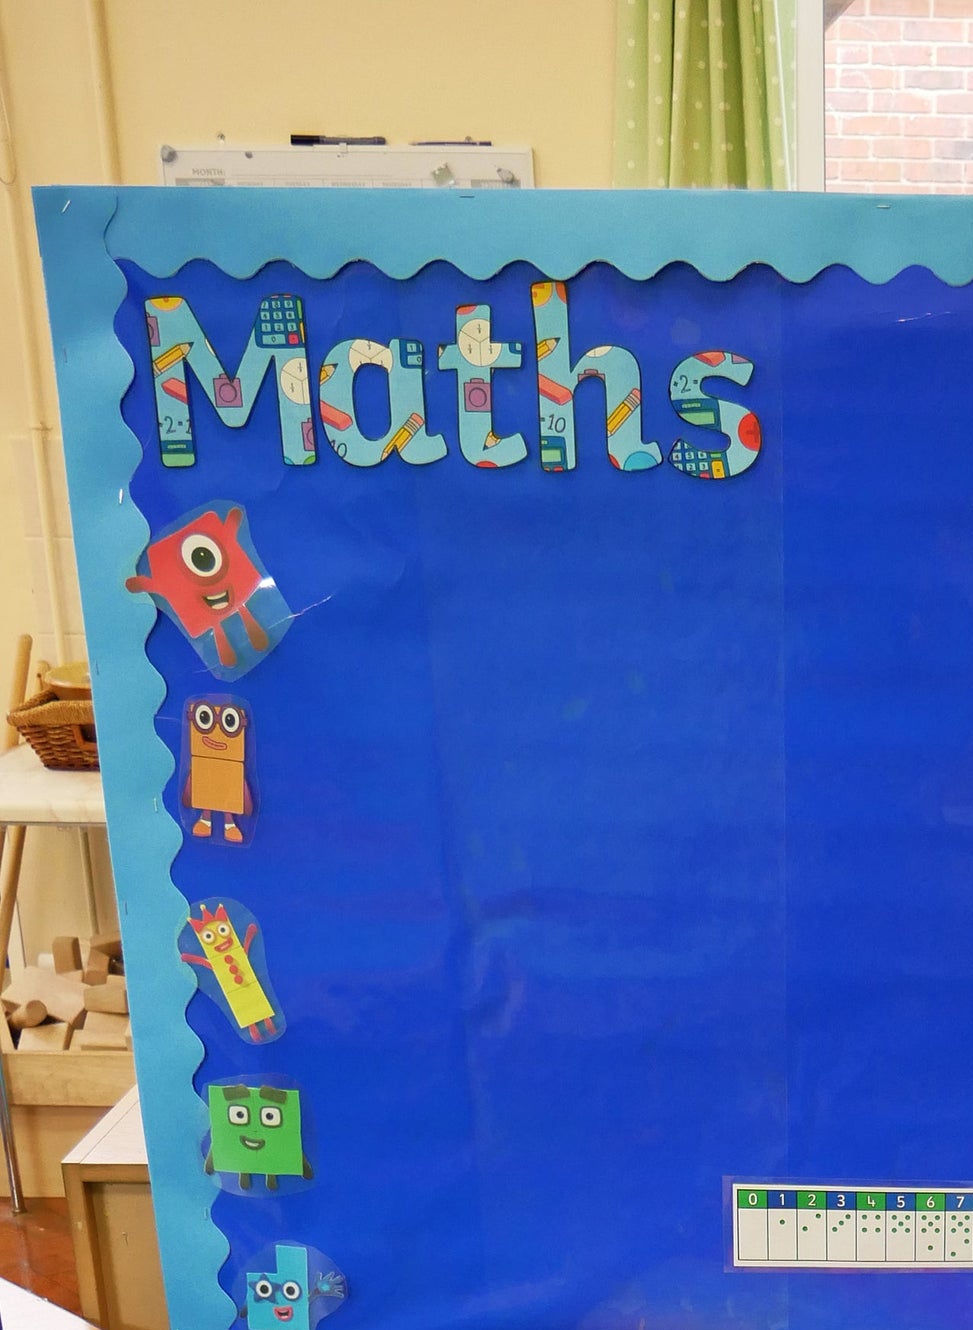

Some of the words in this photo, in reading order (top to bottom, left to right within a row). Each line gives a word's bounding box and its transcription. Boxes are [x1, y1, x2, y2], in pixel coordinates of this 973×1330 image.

[143, 281, 763, 479] Maths
[748, 1192, 758, 1206] 0
[779, 1193, 785, 1206] 1
[807, 1193, 817, 1207] 2
[837, 1194, 846, 1207] 3
[867, 1195, 876, 1208] 4
[896, 1195, 905, 1208] 5
[926, 1196, 935, 1209] 6
[956, 1196, 965, 1209] 7
